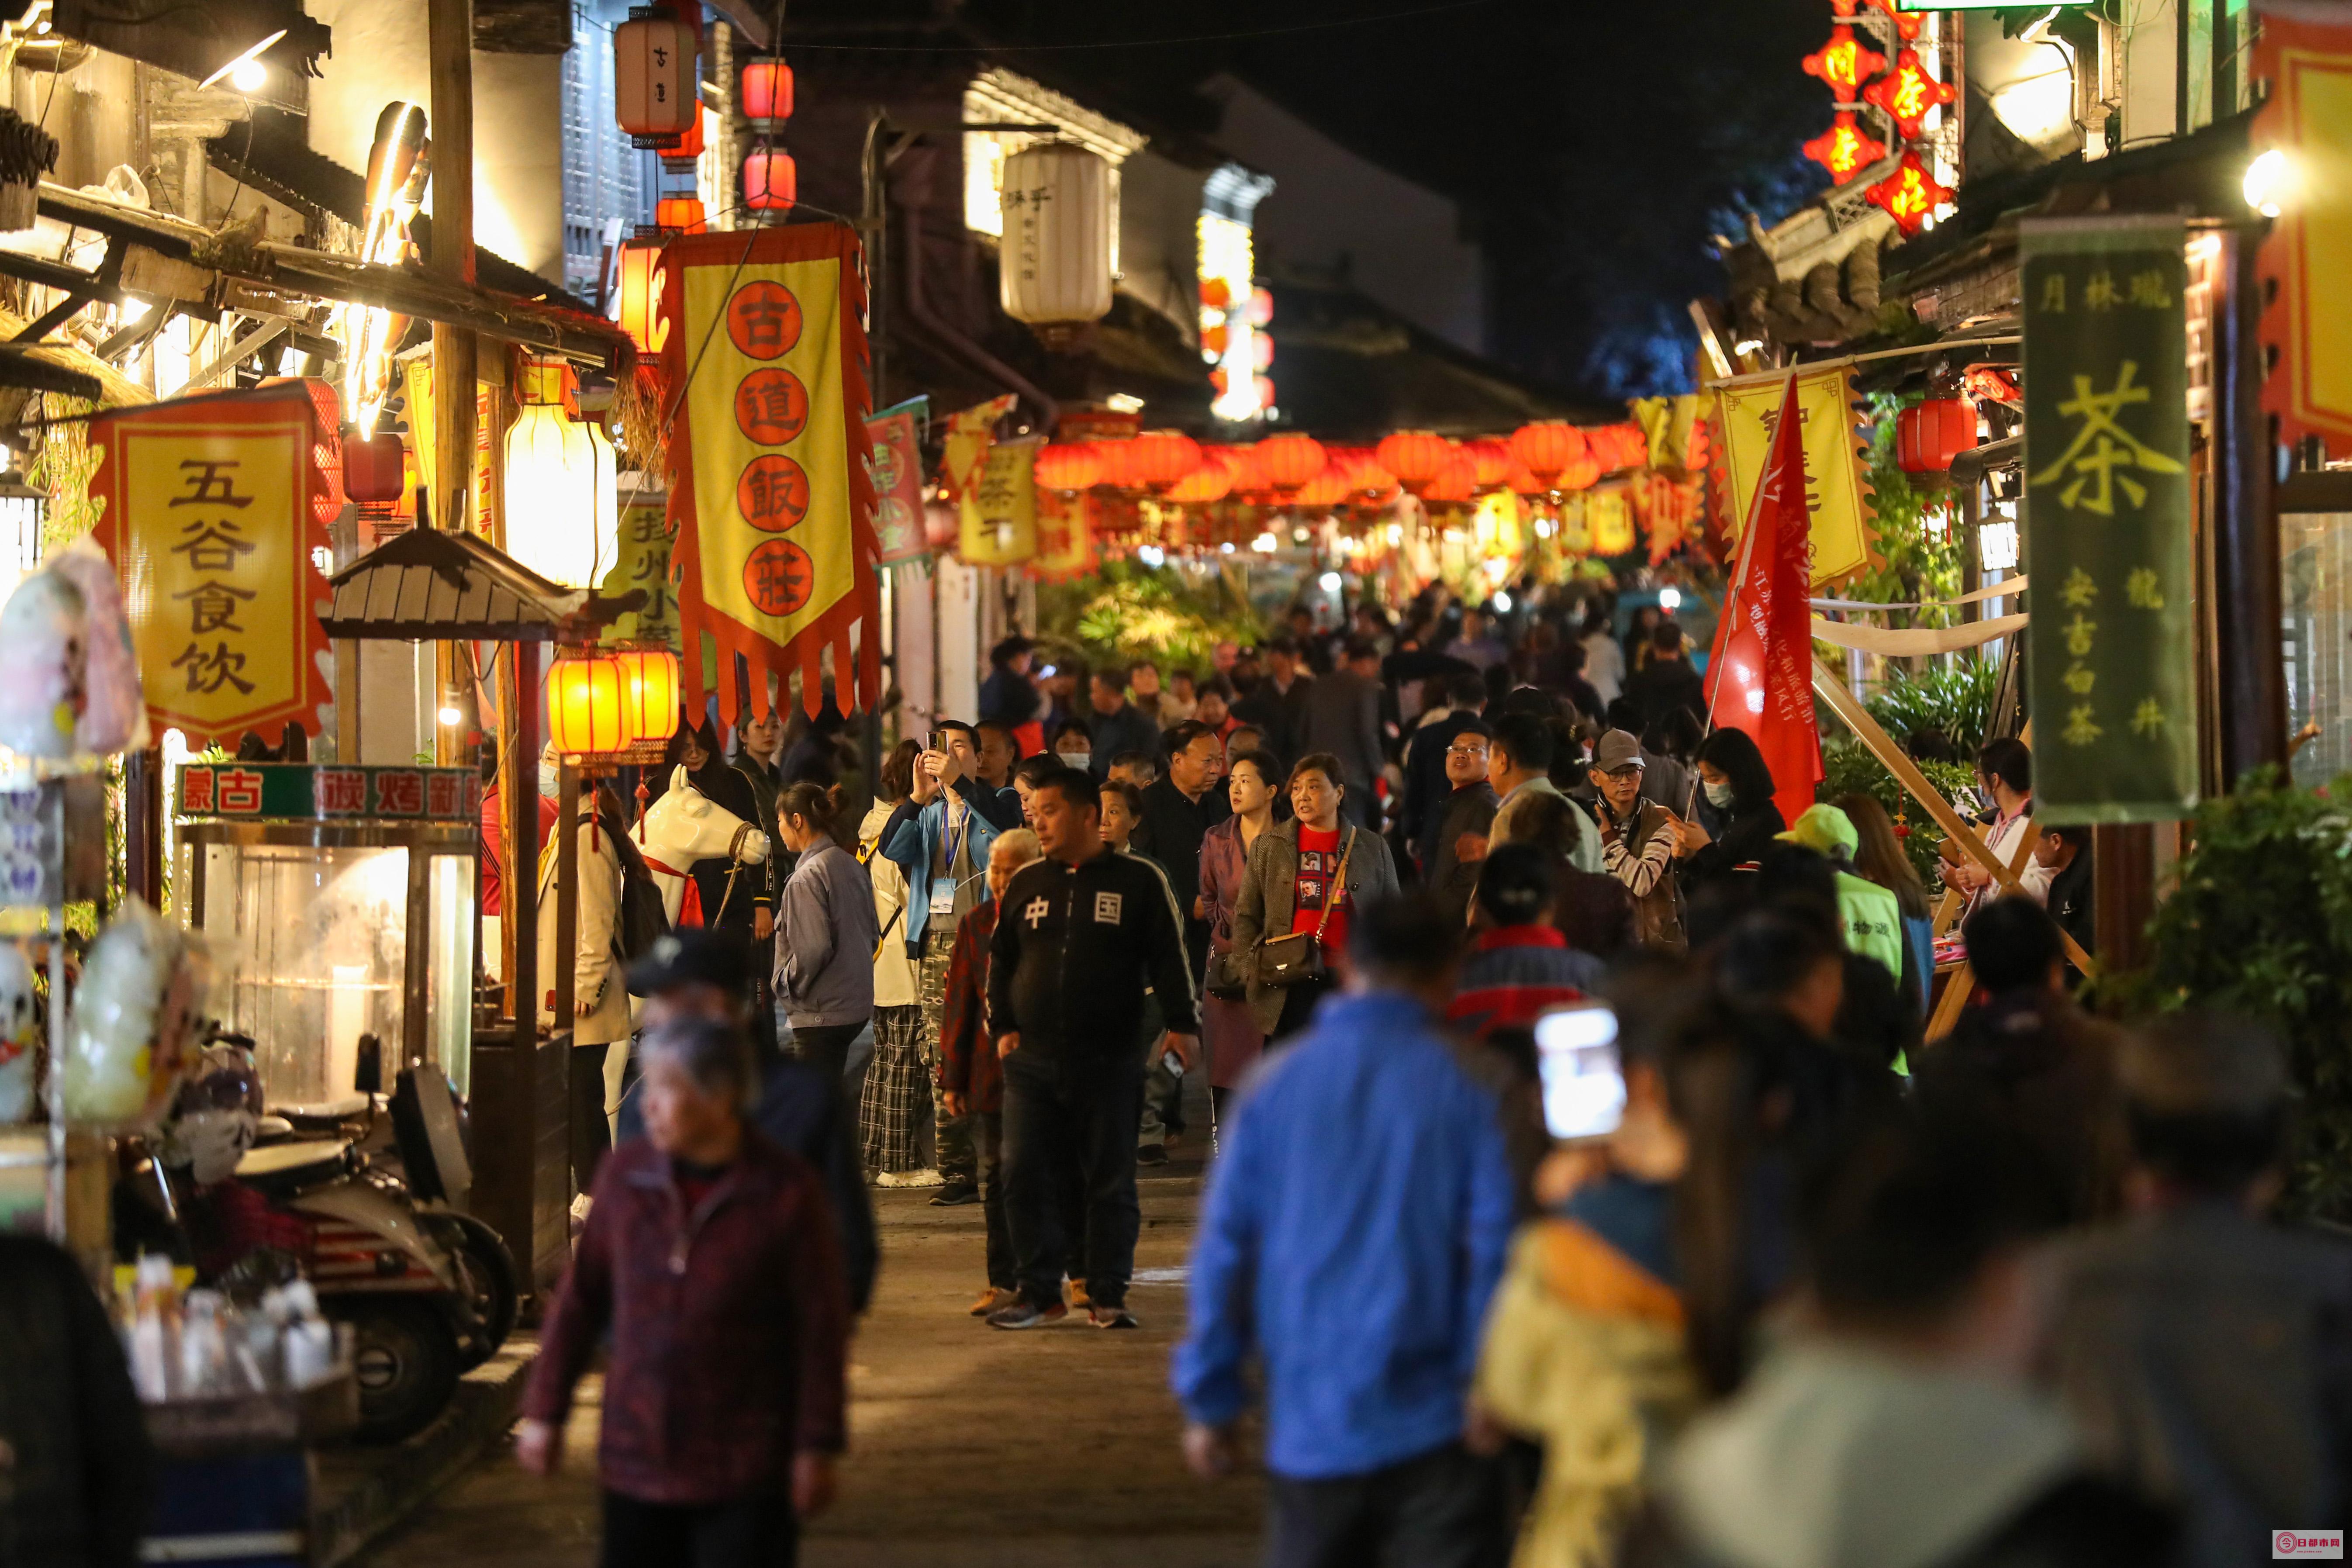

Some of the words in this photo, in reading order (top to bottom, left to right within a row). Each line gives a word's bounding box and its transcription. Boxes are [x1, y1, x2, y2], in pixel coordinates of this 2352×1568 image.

[653, 46, 668, 102] 古道
[739, 292, 806, 608] 古道飯莊
[2027, 361, 2185, 516] 茶
[169, 460, 256, 696] 五谷食饮
[184, 767, 263, 813] 蒙古
